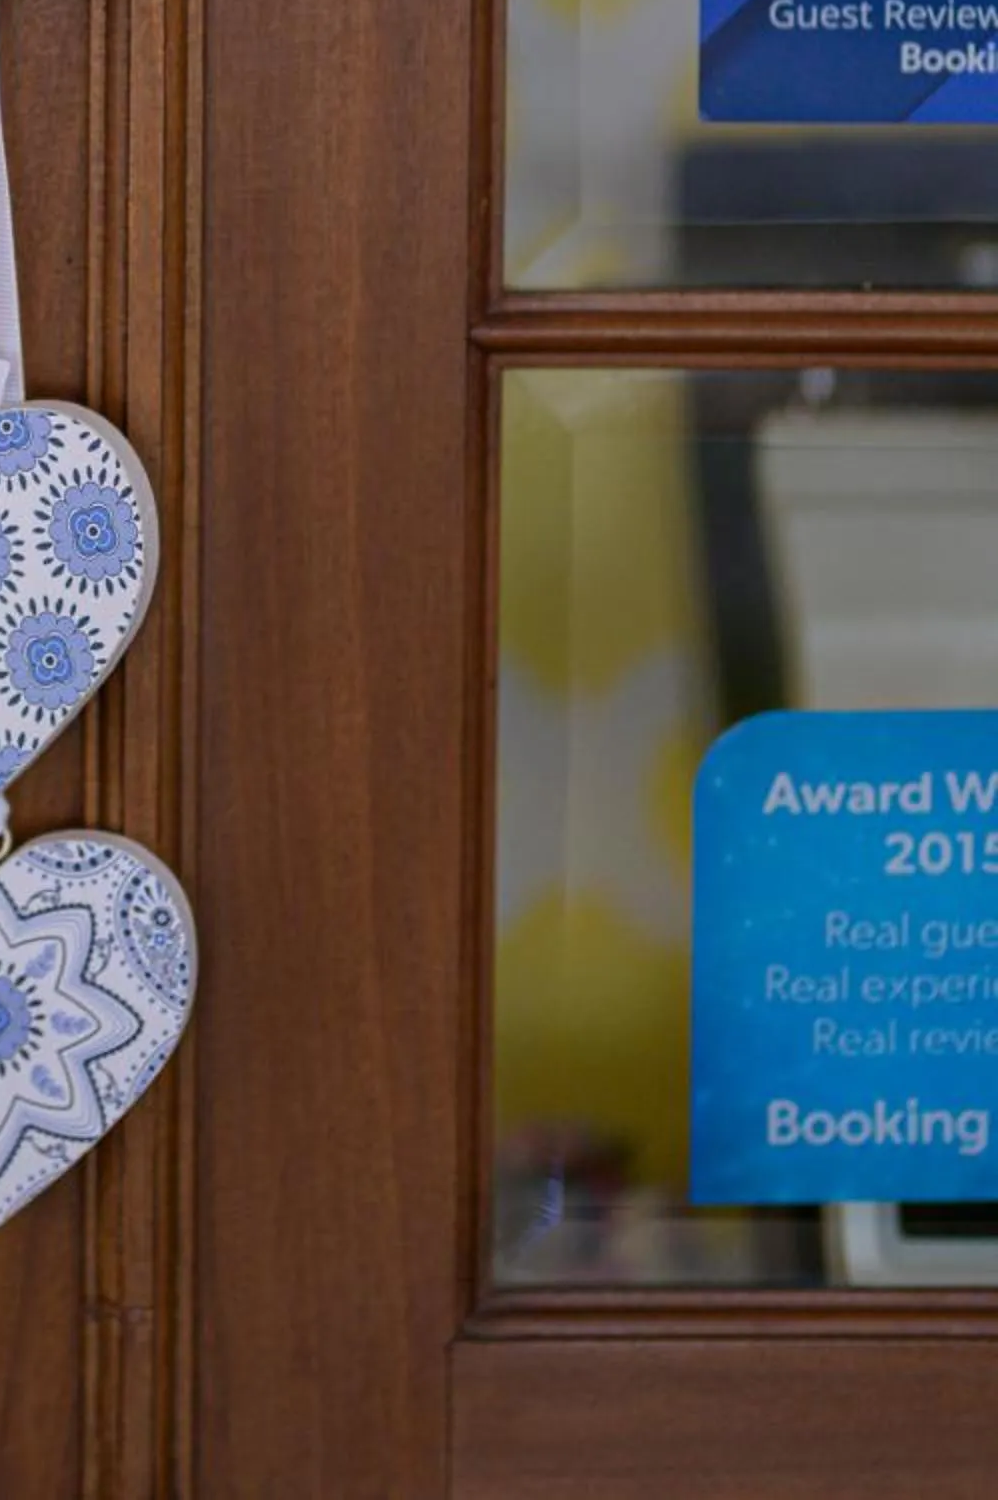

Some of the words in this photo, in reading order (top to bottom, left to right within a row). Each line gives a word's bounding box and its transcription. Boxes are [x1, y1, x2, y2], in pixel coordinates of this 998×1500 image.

[900, 41, 998, 74] Booki
[762, 771, 933, 815] Award
[945, 771, 998, 815] W
[884, 831, 998, 875] 2015
[825, 910, 910, 949] Real
[920, 919, 998, 960] gue
[765, 963, 850, 1002] Real
[861, 964, 998, 1008] experi
[813, 1017, 898, 1056] Real
[909, 1017, 998, 1056] revie
[767, 1097, 989, 1156] Booking
